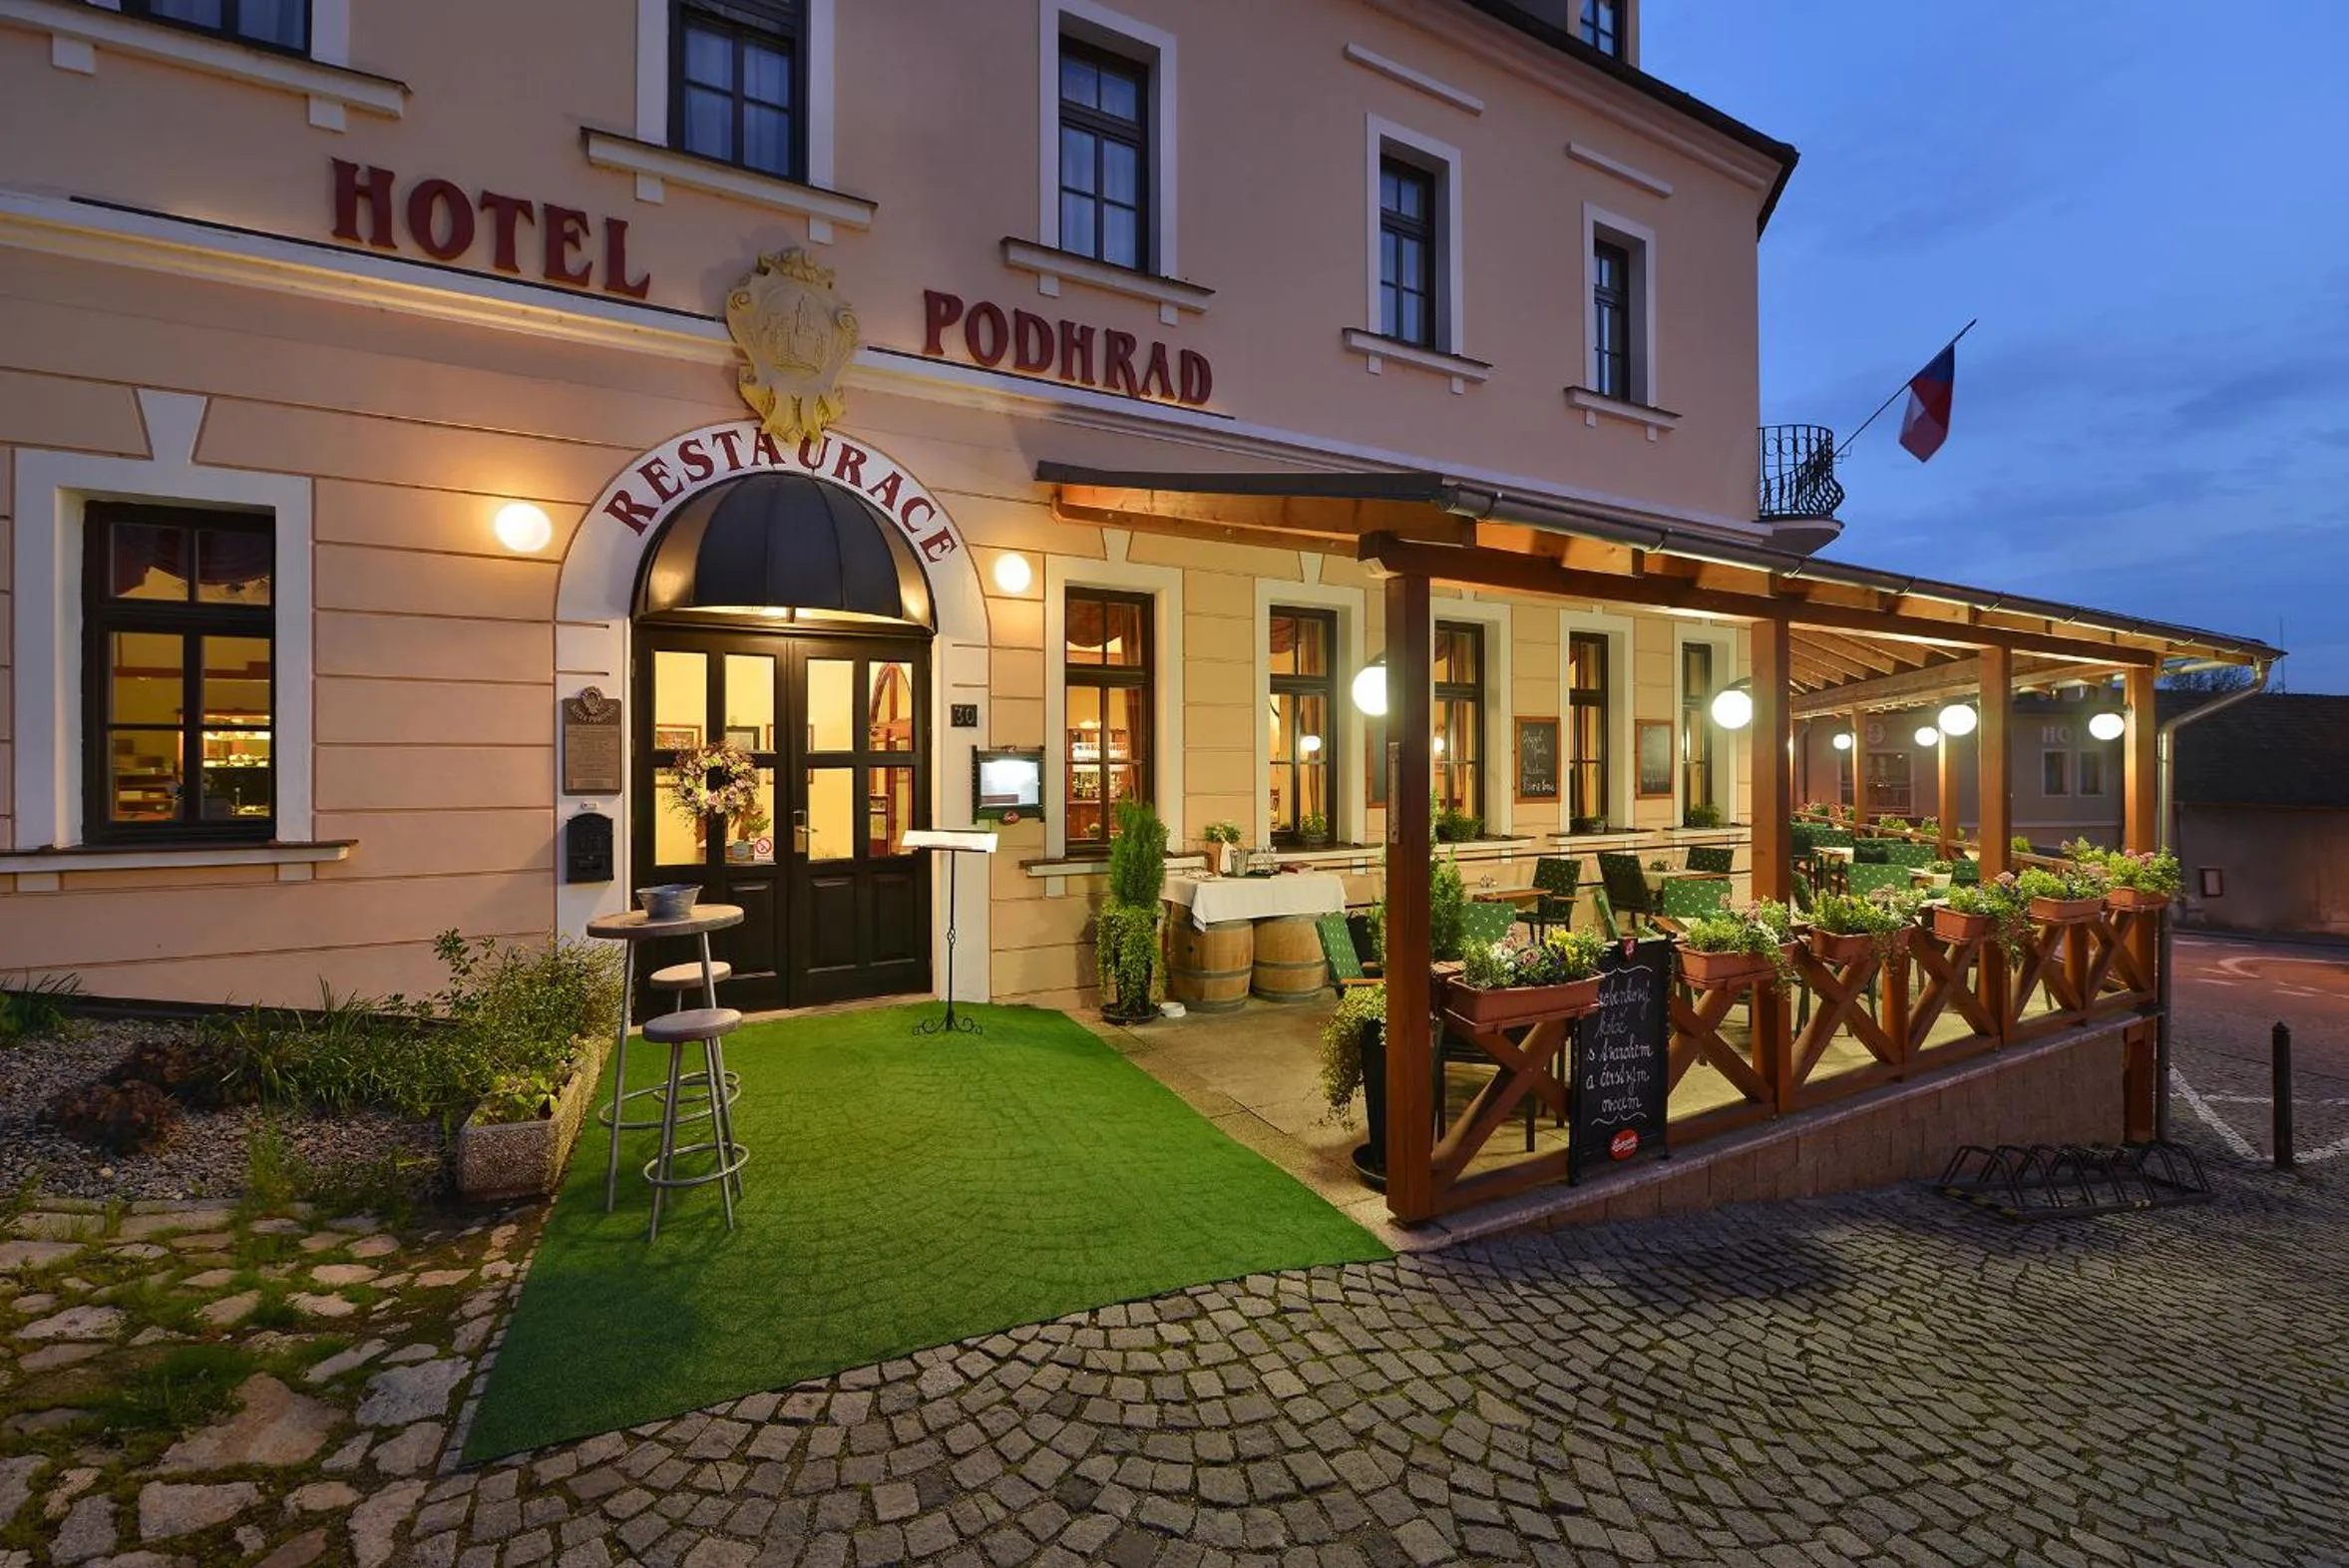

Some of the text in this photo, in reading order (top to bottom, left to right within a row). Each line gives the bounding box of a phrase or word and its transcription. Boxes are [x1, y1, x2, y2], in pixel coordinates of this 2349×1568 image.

[330, 157, 650, 299] HOTEL
[923, 288, 1213, 405] PODHRAD
[603, 426, 958, 564] RESTAURACE
[955, 706, 975, 724] 30
[1585, 1074, 1595, 1090] a
